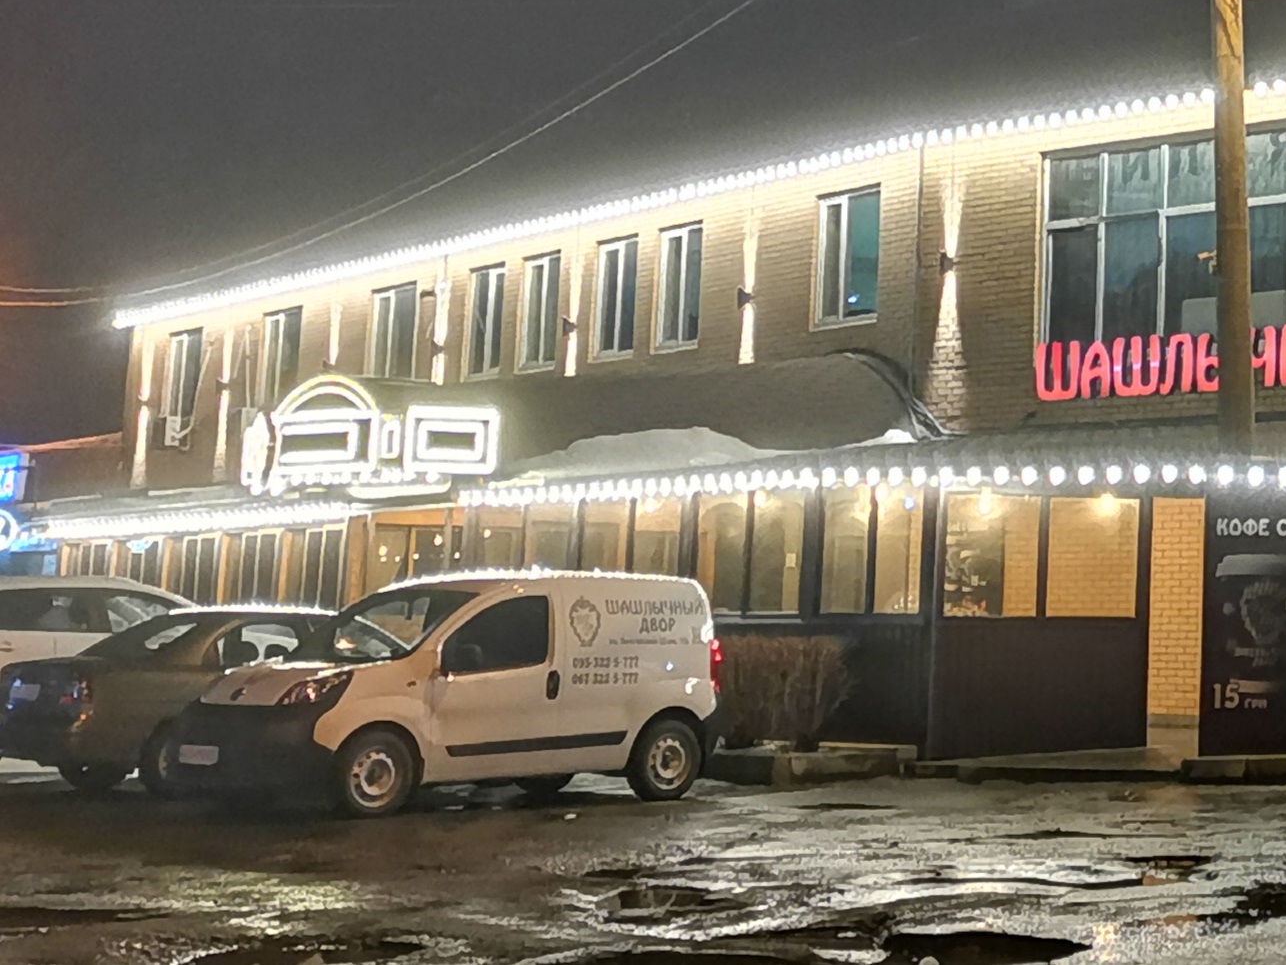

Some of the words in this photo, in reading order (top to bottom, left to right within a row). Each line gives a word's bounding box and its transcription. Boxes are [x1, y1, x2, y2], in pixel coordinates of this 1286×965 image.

[1216, 518, 1270, 536] КОФЕ
[639, 618, 676, 634] ДВОР
[1213, 683, 1240, 709] 15
